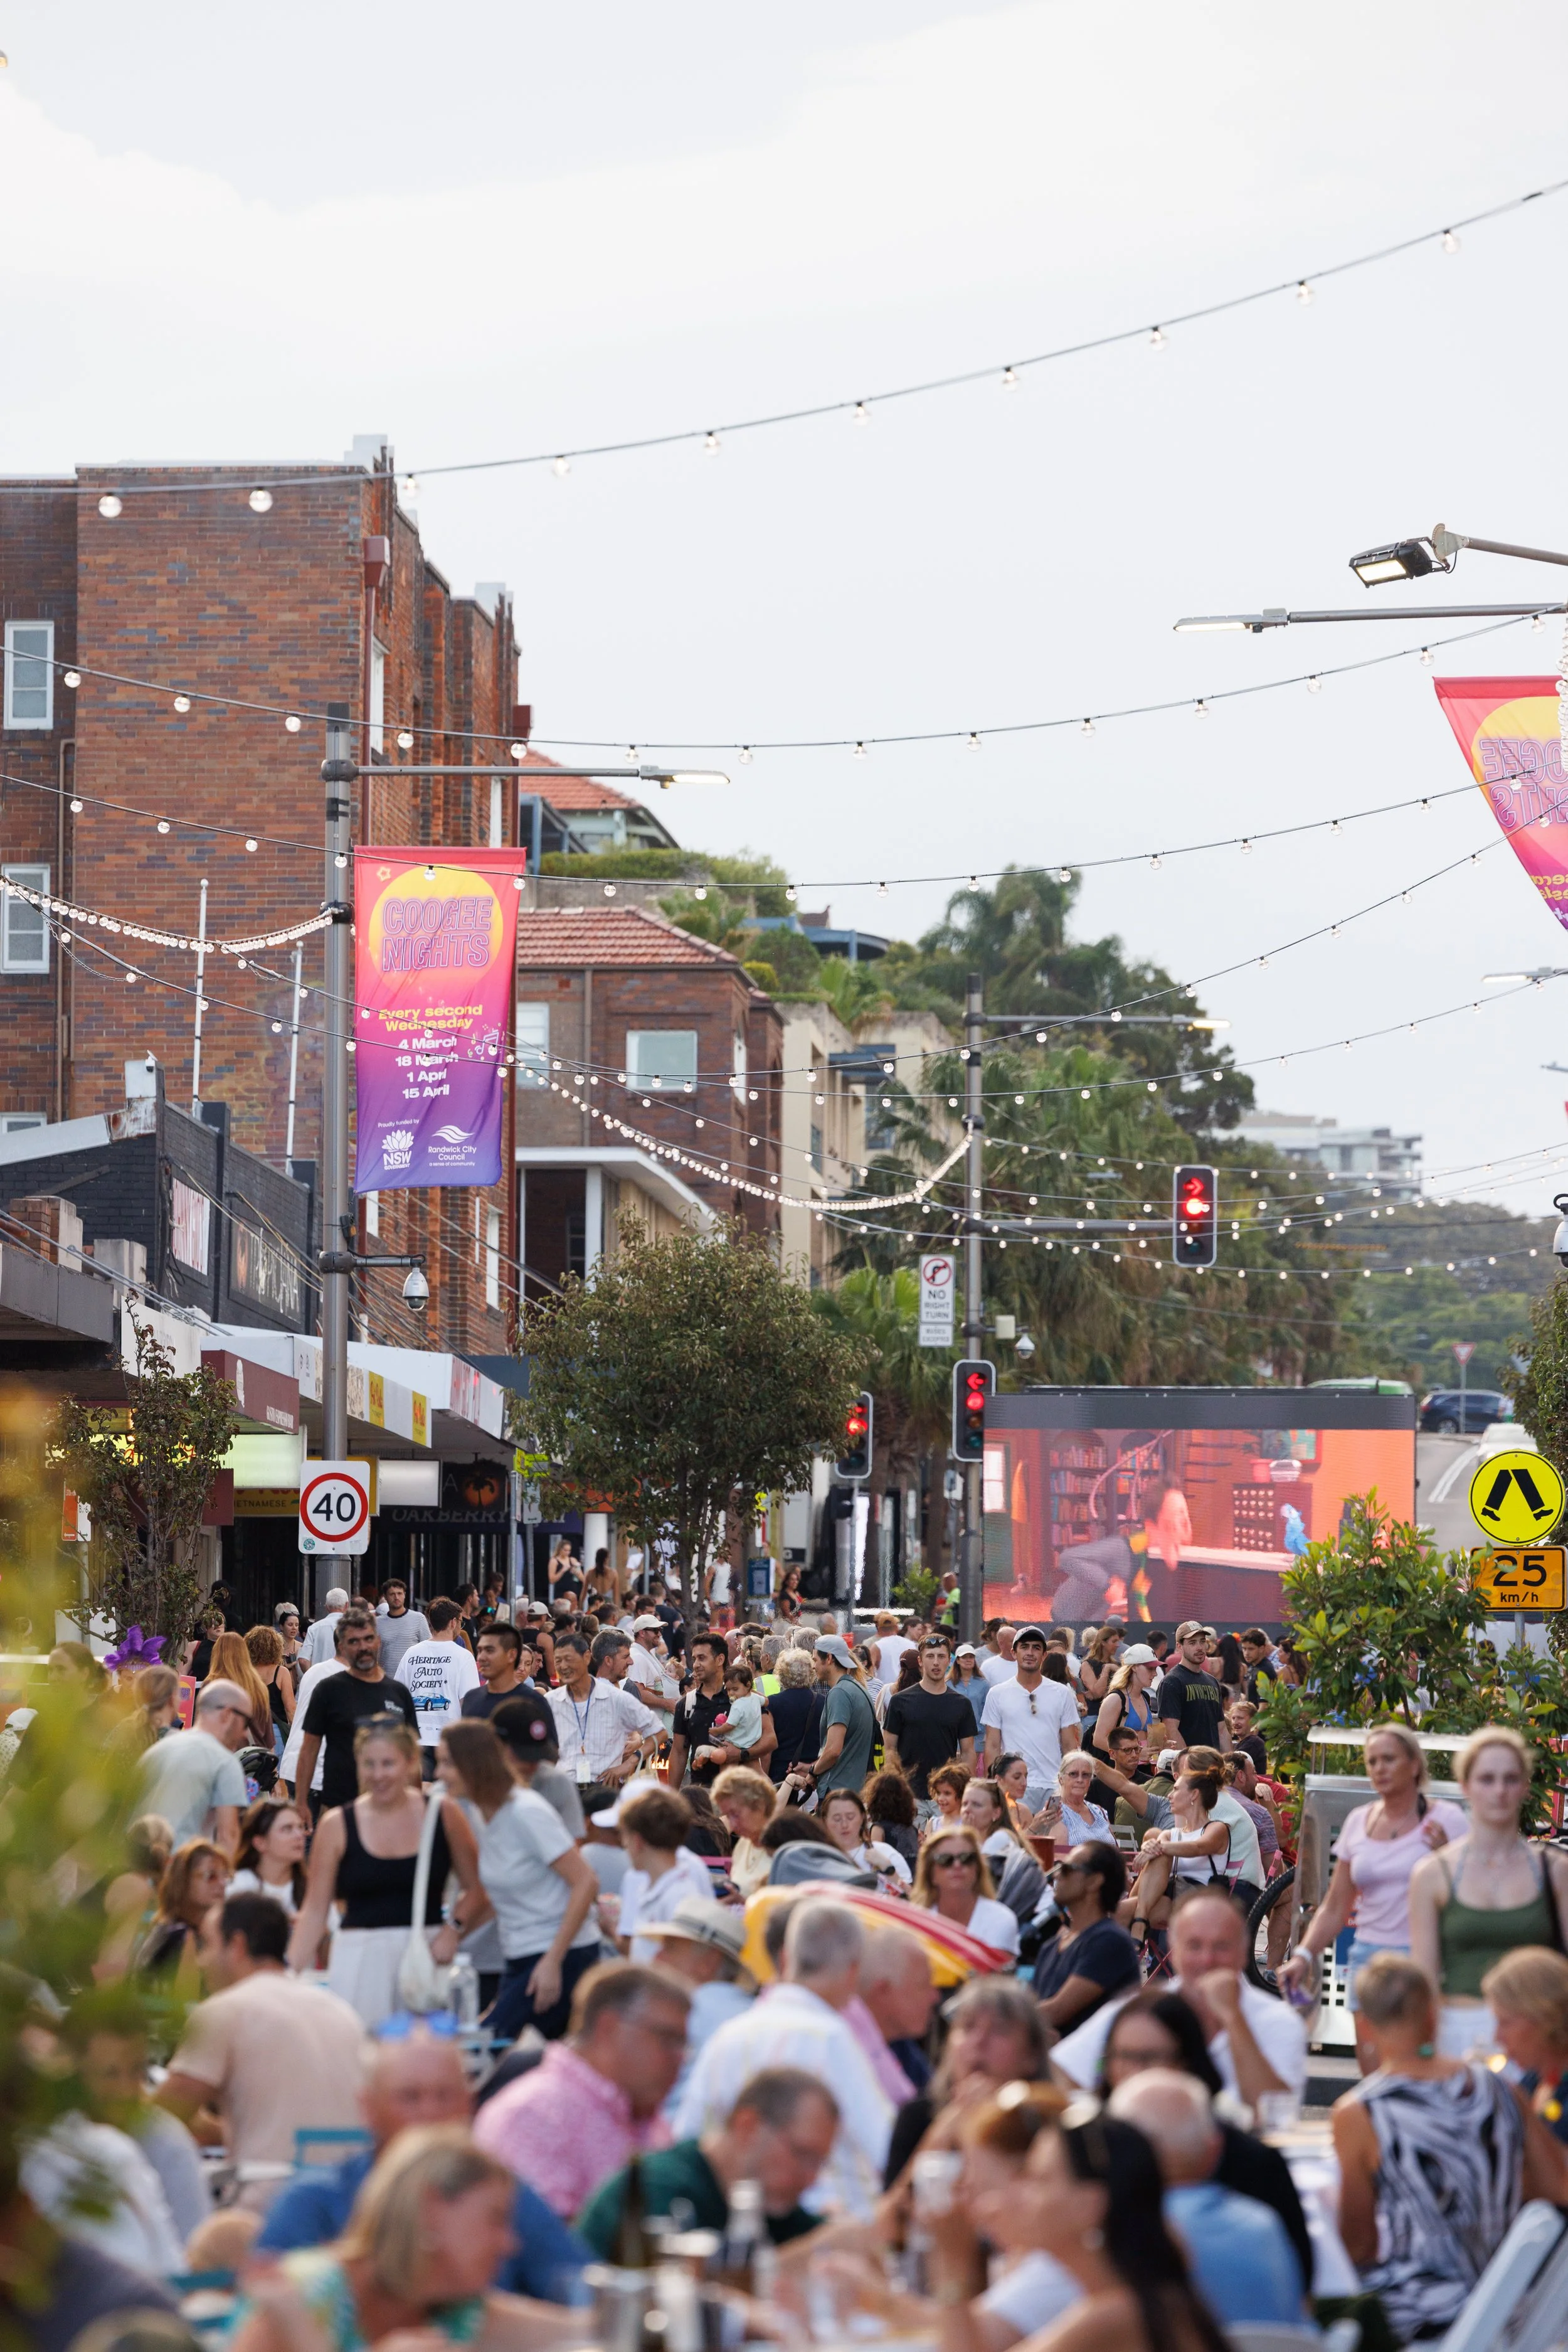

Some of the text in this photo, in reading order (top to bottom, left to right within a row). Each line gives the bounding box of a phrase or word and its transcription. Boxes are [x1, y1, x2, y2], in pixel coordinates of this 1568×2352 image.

[383, 898, 492, 934] COOGEE
[383, 933, 489, 971] NIGHTS
[378, 1004, 483, 1020] Every second
[385, 1017, 474, 1032] Wednesday
[398, 1036, 457, 1050] 4 March
[395, 1056, 412, 1067] 18
[406, 1068, 447, 1083] 1 Aprl
[402, 1084, 450, 1099] 15 April
[428, 1146, 477, 1154] Randwick City
[383, 1151, 412, 1166] NSW
[928, 1290, 946, 1299] NO
[234, 1499, 287, 1508] IETNAMESE
[312, 1493, 356, 1523] 40
[391, 1508, 509, 1523] OAKBERRY
[1493, 1555, 1547, 1587] 25
[1500, 1592, 1539, 1603] km/h
[408, 1656, 452, 1666] HERITAGE
[413, 1666, 443, 1679] AUTO
